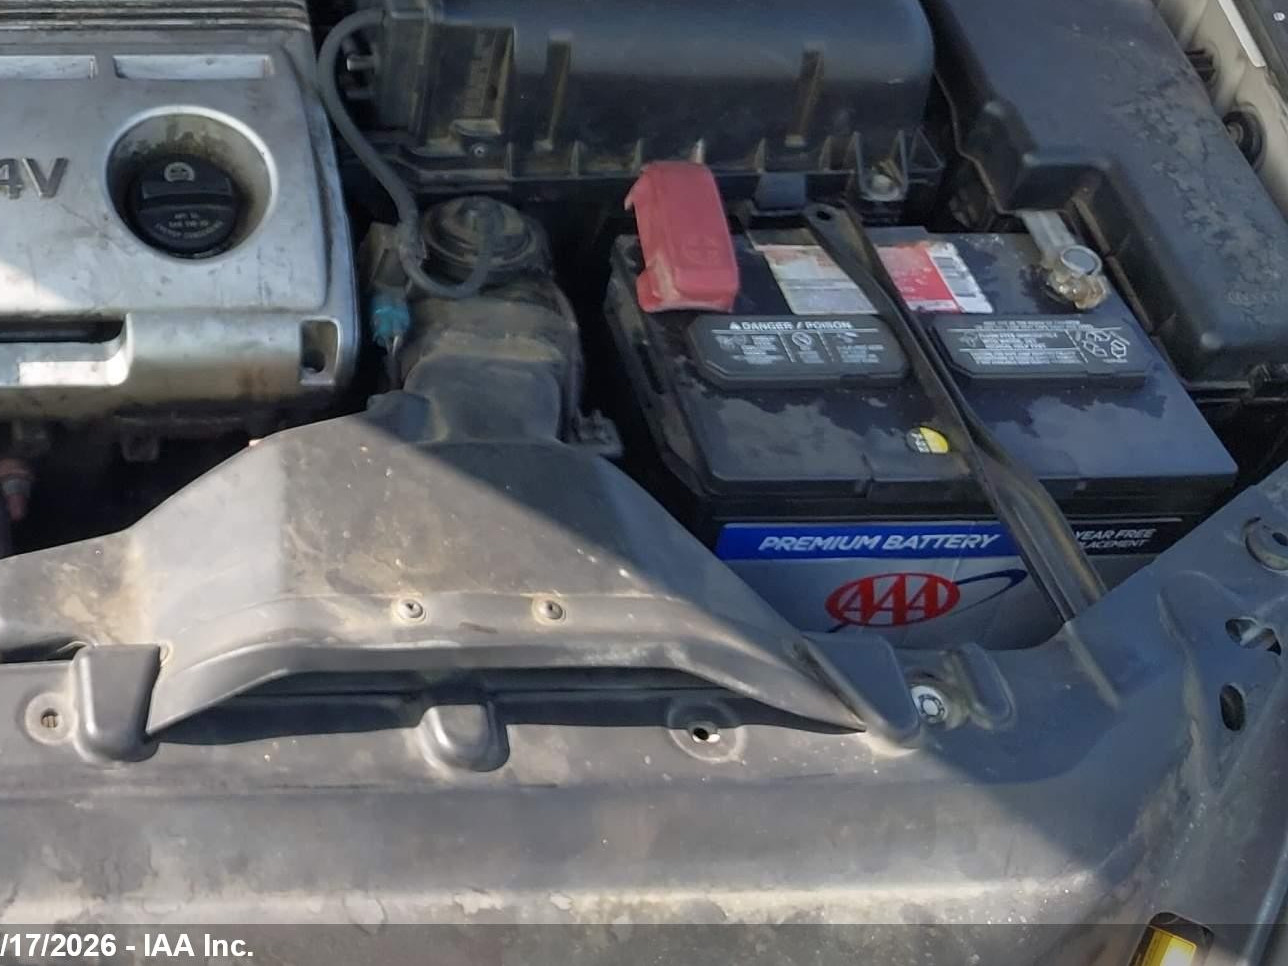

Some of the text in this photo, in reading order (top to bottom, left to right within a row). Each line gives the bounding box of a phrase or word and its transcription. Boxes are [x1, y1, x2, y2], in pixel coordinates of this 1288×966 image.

[741, 322, 792, 330] DANGER
[805, 321, 852, 329] POISON
[1076, 529, 1157, 540] YEAR FREE
[759, 533, 1000, 551] PREMIUM BATTERY
[1078, 540, 1151, 548] LACEMENT
[828, 572, 958, 627] AAA
